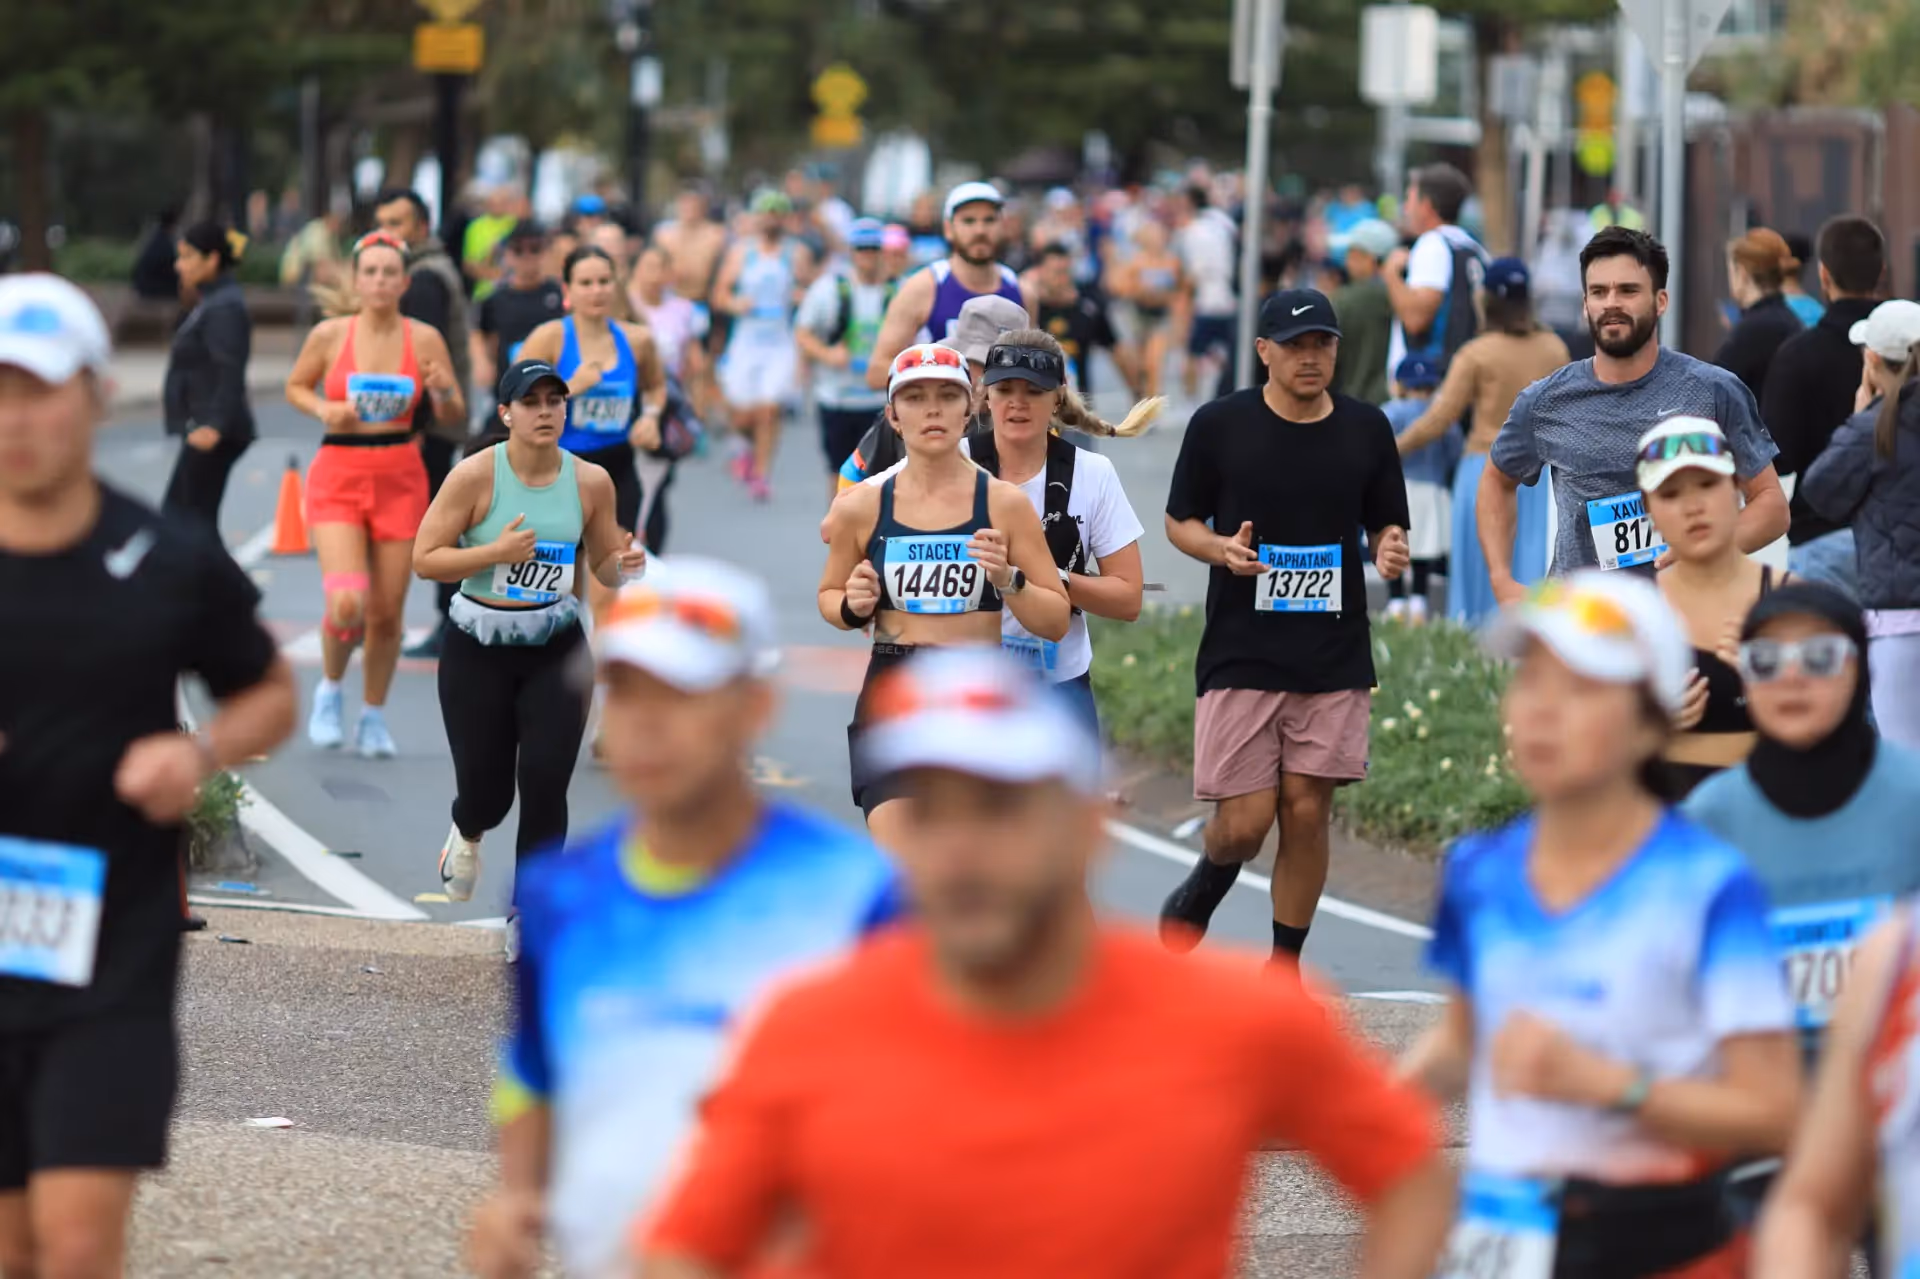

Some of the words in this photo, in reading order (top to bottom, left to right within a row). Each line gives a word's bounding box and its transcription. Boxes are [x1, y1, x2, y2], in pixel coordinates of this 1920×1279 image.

[1614, 518, 1660, 553] 817
[908, 543, 961, 560] STACEY
[506, 560, 563, 591] 9072
[894, 563, 977, 597] 14469
[1268, 569, 1333, 598] 13722
